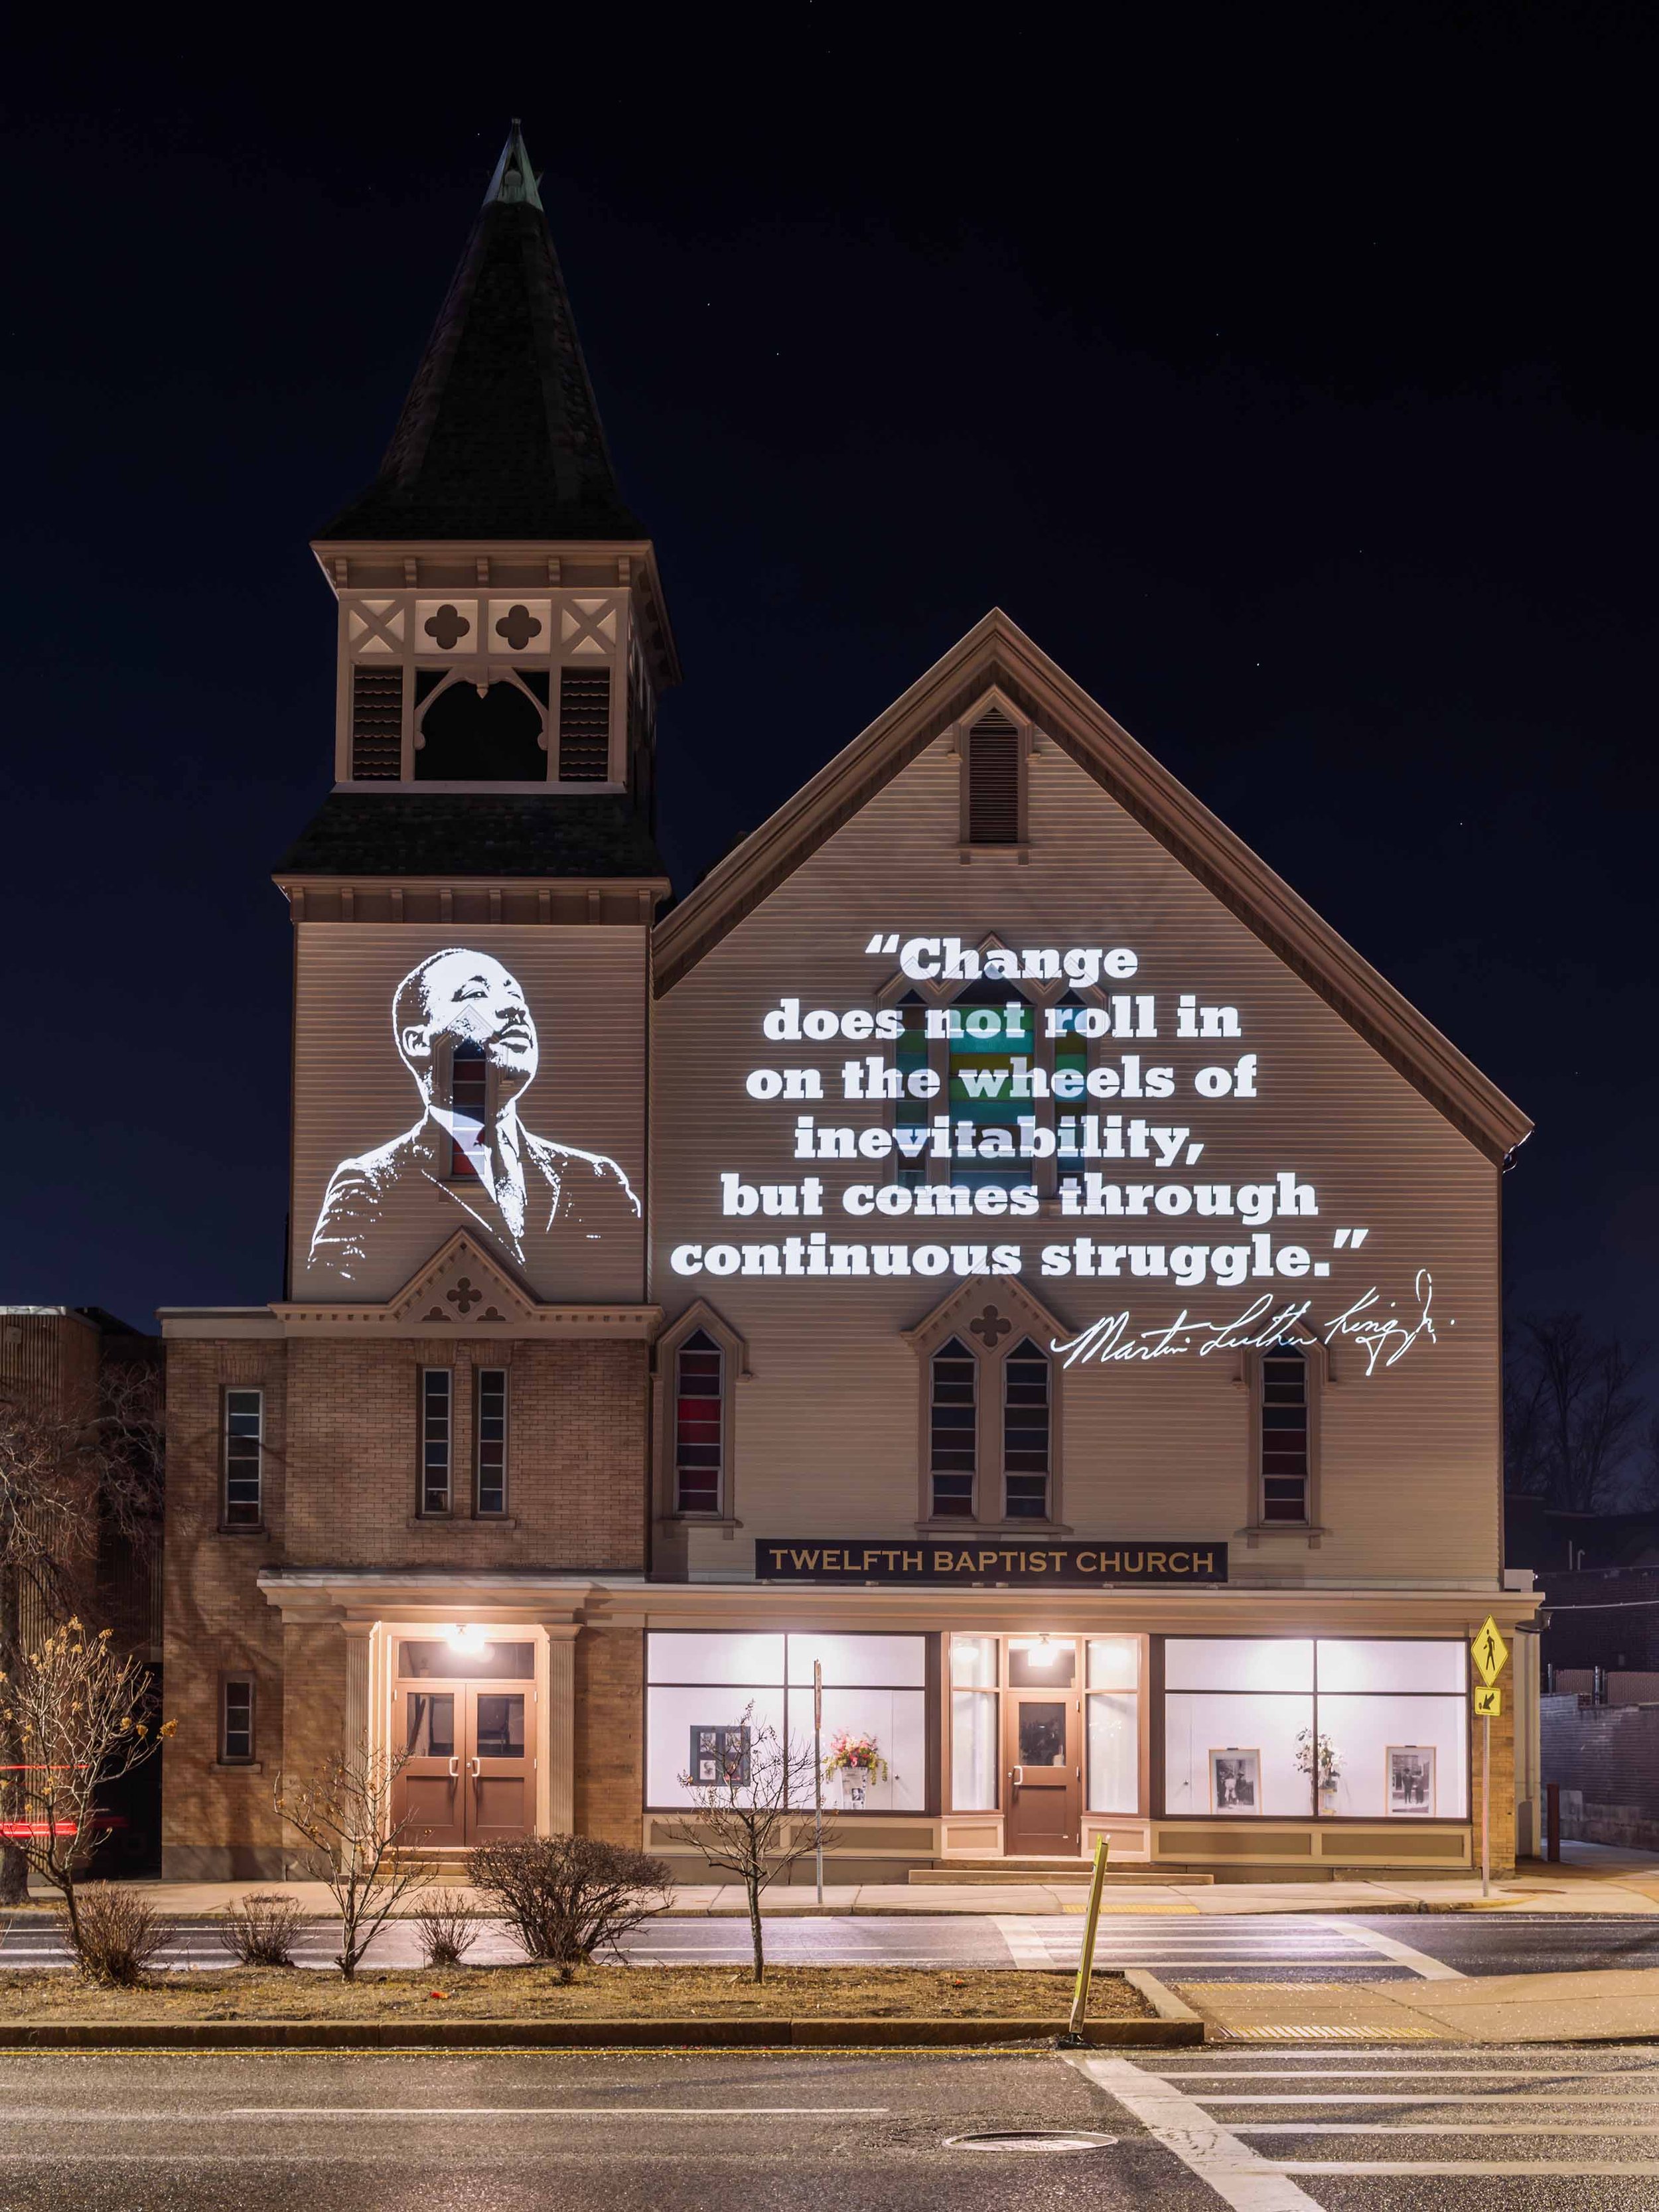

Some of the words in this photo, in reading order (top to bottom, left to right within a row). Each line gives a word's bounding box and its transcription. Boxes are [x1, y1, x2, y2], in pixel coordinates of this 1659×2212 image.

[763, 997, 906, 1040] does
[924, 1001, 1025, 1040] not
[1044, 995, 1157, 1039] roll
[1176, 995, 1242, 1038] in
[746, 1068, 824, 1099] on
[841, 1056, 940, 1099] the
[958, 1055, 1175, 1099] wheels
[1194, 1054, 1258, 1098] of
[794, 1115, 1204, 1167] inevitability,
[721, 1173, 824, 1216] but
[842, 1184, 1040, 1215] comes
[1058, 1172, 1319, 1226] through
[670, 1232, 1022, 1276] continuous
[1050, 1310, 1211, 1369] Martin
[1199, 1293, 1317, 1356] Luther
[1325, 1286, 1408, 1376] King
[769, 1549, 924, 1572] TWELFTH
[933, 1551, 1068, 1572] BAPTIST
[1076, 1551, 1214, 1573] CHURCH
